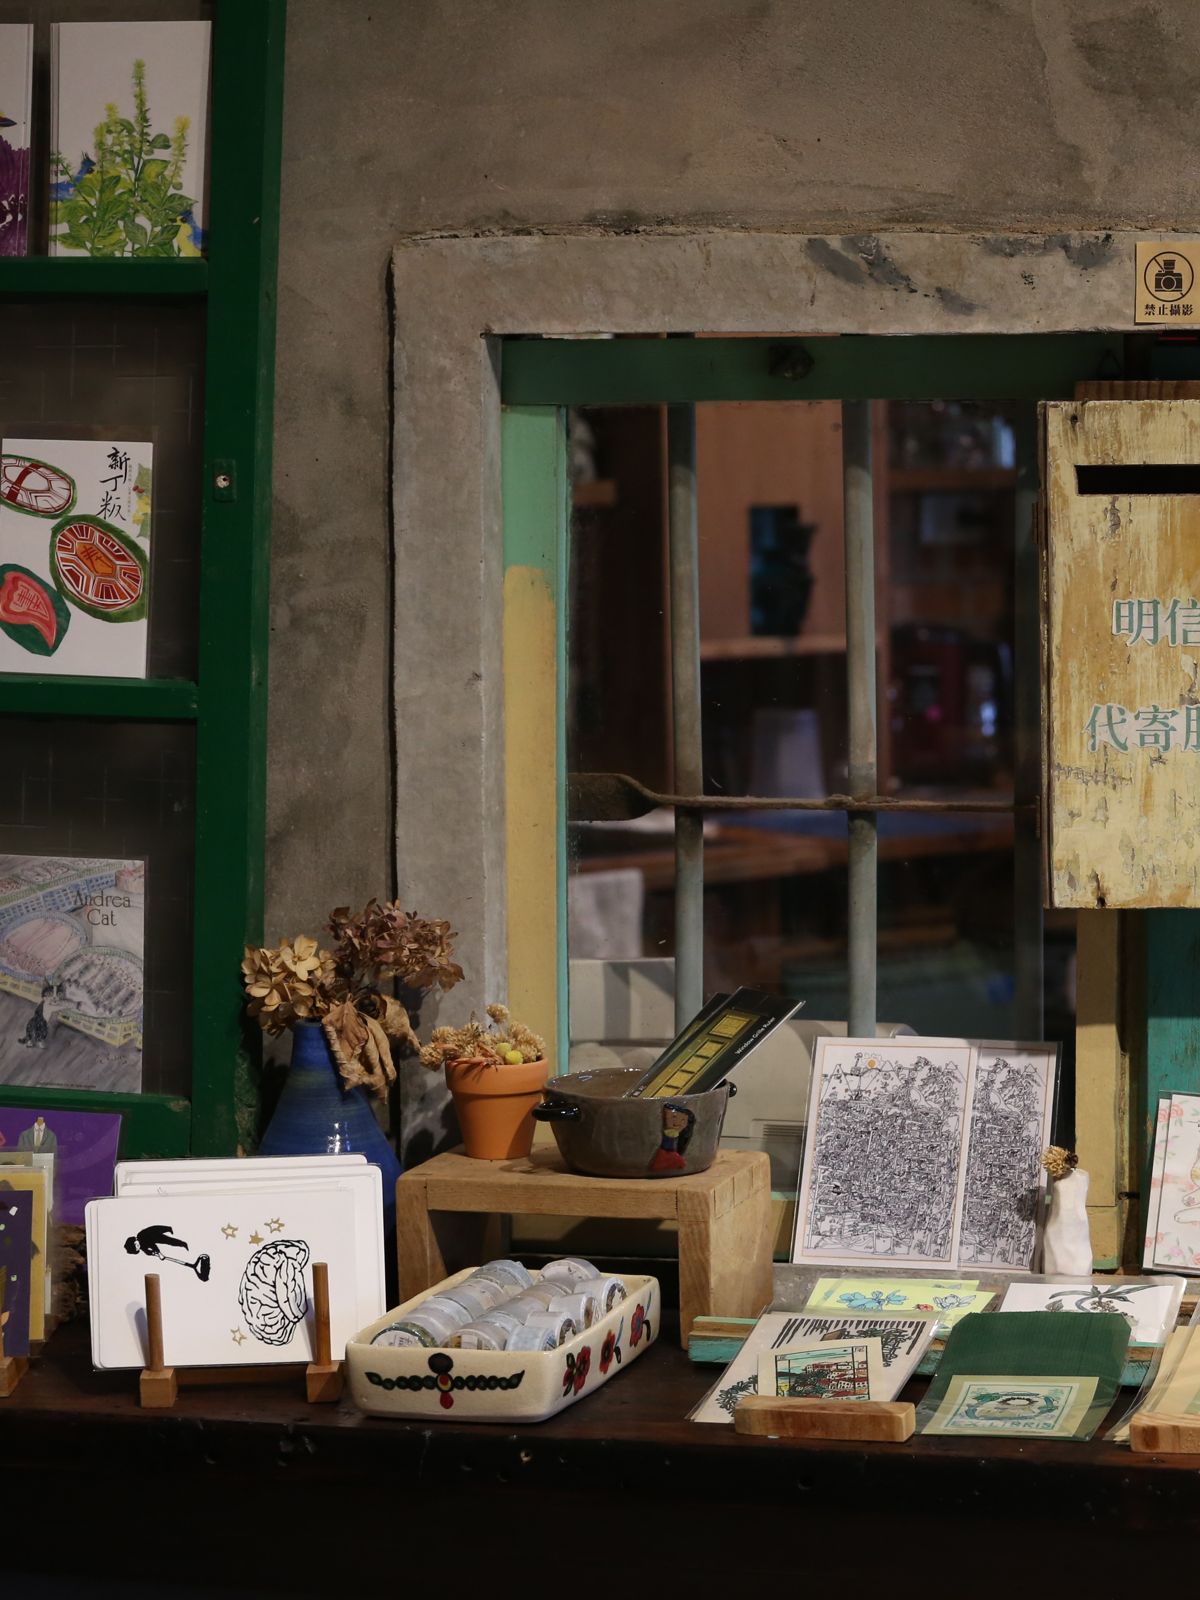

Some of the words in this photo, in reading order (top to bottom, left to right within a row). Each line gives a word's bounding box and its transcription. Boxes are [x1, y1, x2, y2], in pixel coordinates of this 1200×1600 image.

[1144, 303, 1193, 317] 禁止攝影
[74, 890, 131, 908] Andrea
[87, 908, 117, 926] Cat
